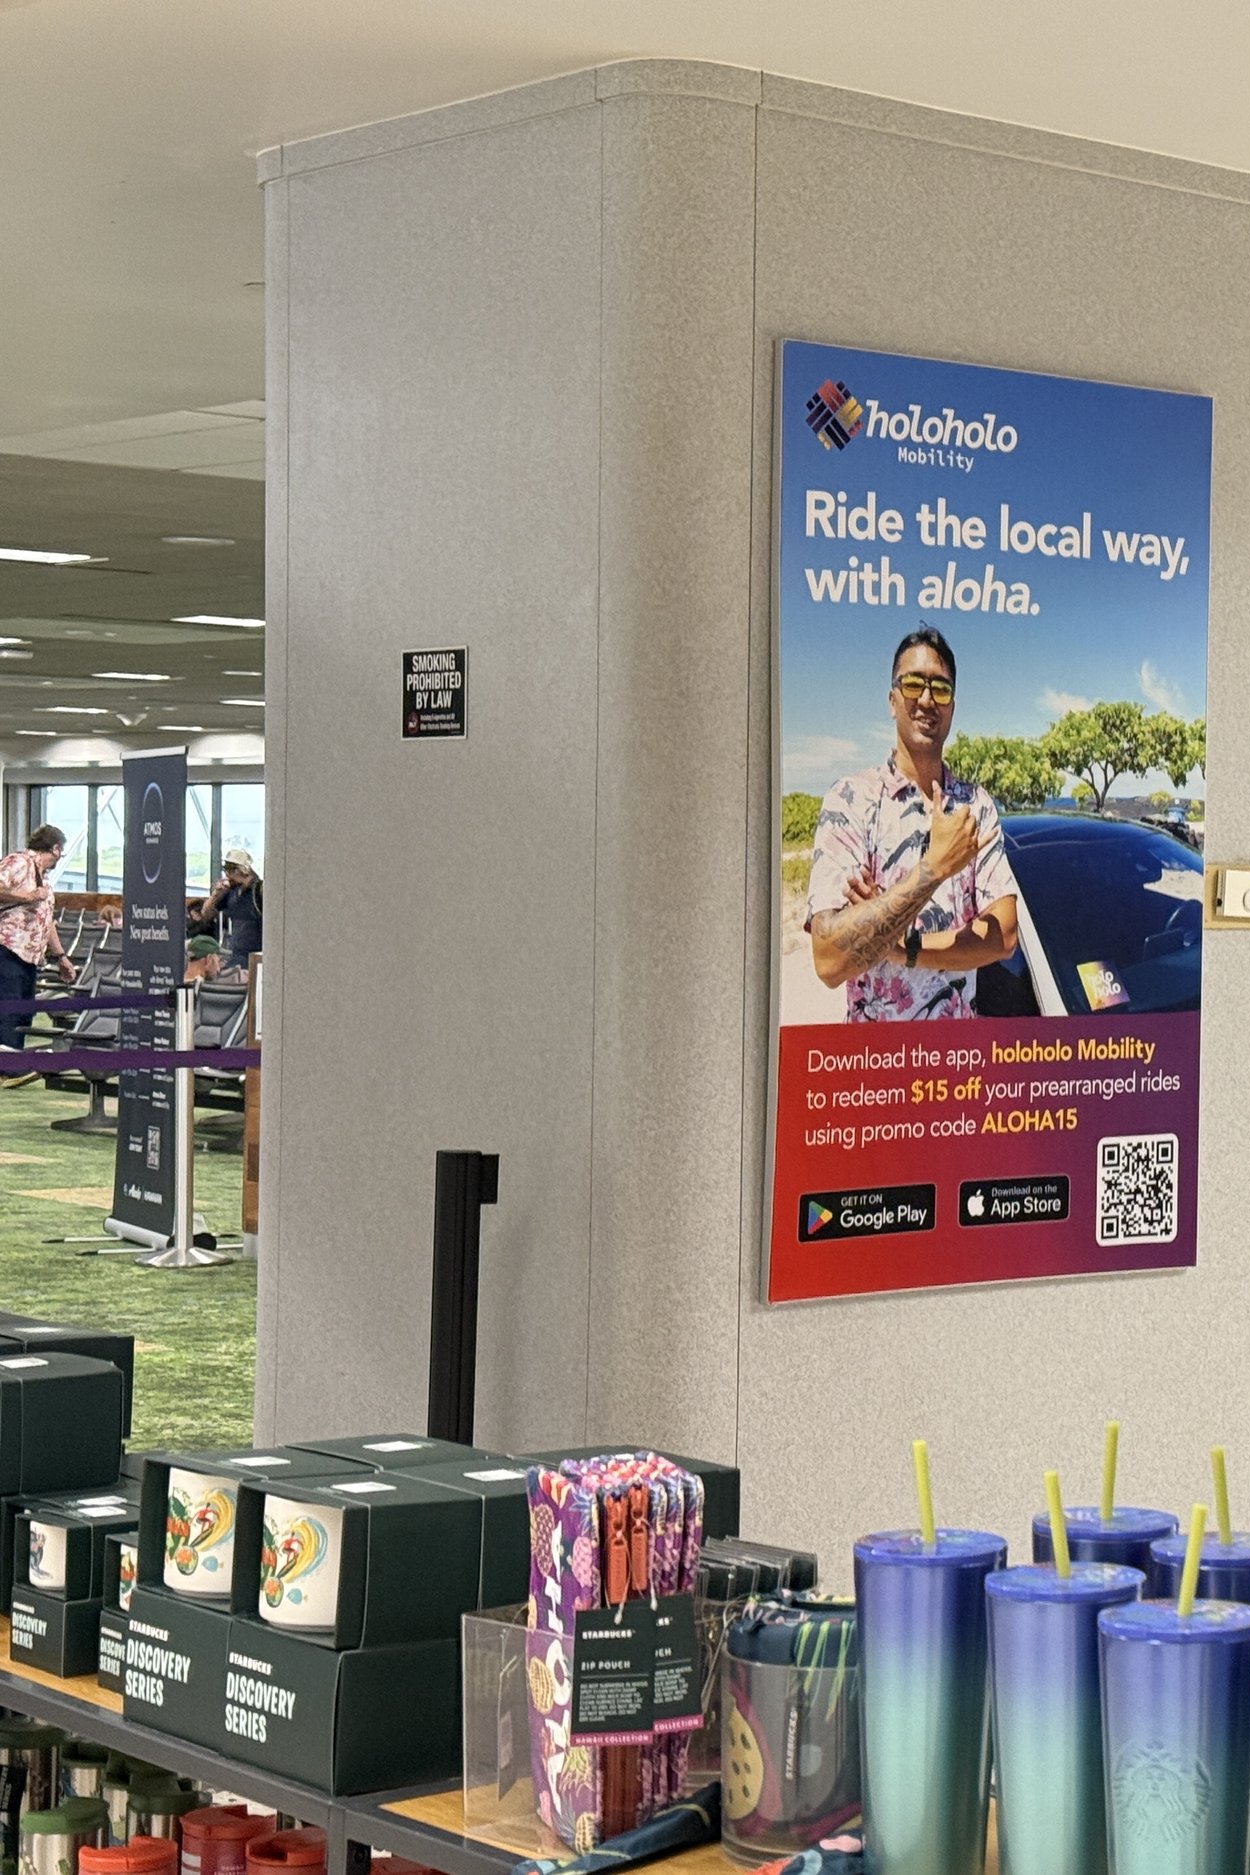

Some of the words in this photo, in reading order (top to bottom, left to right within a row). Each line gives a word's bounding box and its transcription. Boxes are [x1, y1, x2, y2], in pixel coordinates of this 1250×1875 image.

[865, 399, 1018, 453] holoholo
[898, 447, 974, 473] Mobility
[805, 490, 904, 543] Ride
[916, 497, 987, 550] the
[1000, 503, 1092, 559] local
[1102, 529, 1189, 580] way,
[805, 556, 905, 606] with
[917, 561, 1040, 616] aloha.
[412, 652, 456, 672] SMOKING
[407, 671, 461, 691] PROHIBITED
[416, 691, 429, 709] BY
[431, 690, 452, 708] LAW
[143, 821, 162, 836] ATMOS
[807, 1043, 905, 1073] Download
[910, 1042, 941, 1067] the
[946, 1048, 986, 1071] app,
[991, 1038, 1072, 1063] holoholo
[1077, 1036, 1155, 1065] Mobility
[806, 1089, 826, 1109] to
[832, 1082, 905, 1108] redeem
[911, 1078, 948, 1104] $15
[954, 1076, 982, 1100] off
[985, 1081, 1025, 1106] your
[1030, 1070, 1136, 1103] prearranged
[1141, 1069, 1181, 1092] rides
[805, 1122, 856, 1150] using
[861, 1121, 925, 1148] promo
[930, 1112, 976, 1137] code
[981, 1107, 1078, 1134] ALOHA15
[841, 1195, 859, 1207] GET
[860, 1194, 868, 1205] IT
[868, 1193, 883, 1205] ON
[991, 1185, 1031, 1196] Download
[1033, 1186, 1043, 1195] on
[1044, 1184, 1058, 1194] the
[840, 1206, 895, 1230] Google
[897, 1204, 928, 1226] Play
[991, 1198, 1021, 1219] App
[1023, 1196, 1062, 1214] Store
[12, 1611, 47, 1637] DISCOVERY
[129, 1619, 169, 1642] STARBUCKS
[582, 1629, 633, 1640] STARBUCKS
[12, 1628, 33, 1650] SERIES
[100, 1637, 126, 1662] DISCOVE
[126, 1638, 191, 1683] DISCOVERY
[229, 1652, 272, 1676] STARBUCKS
[581, 1660, 596, 1671] ZIP
[598, 1660, 631, 1670] POUCH
[125, 1669, 164, 1707] SERIES
[225, 1671, 296, 1720] DISCOVERY
[225, 1703, 267, 1743] SERIES
[654, 1719, 699, 1732] COLLECTION
[605, 1734, 649, 1743] COLLECTION
